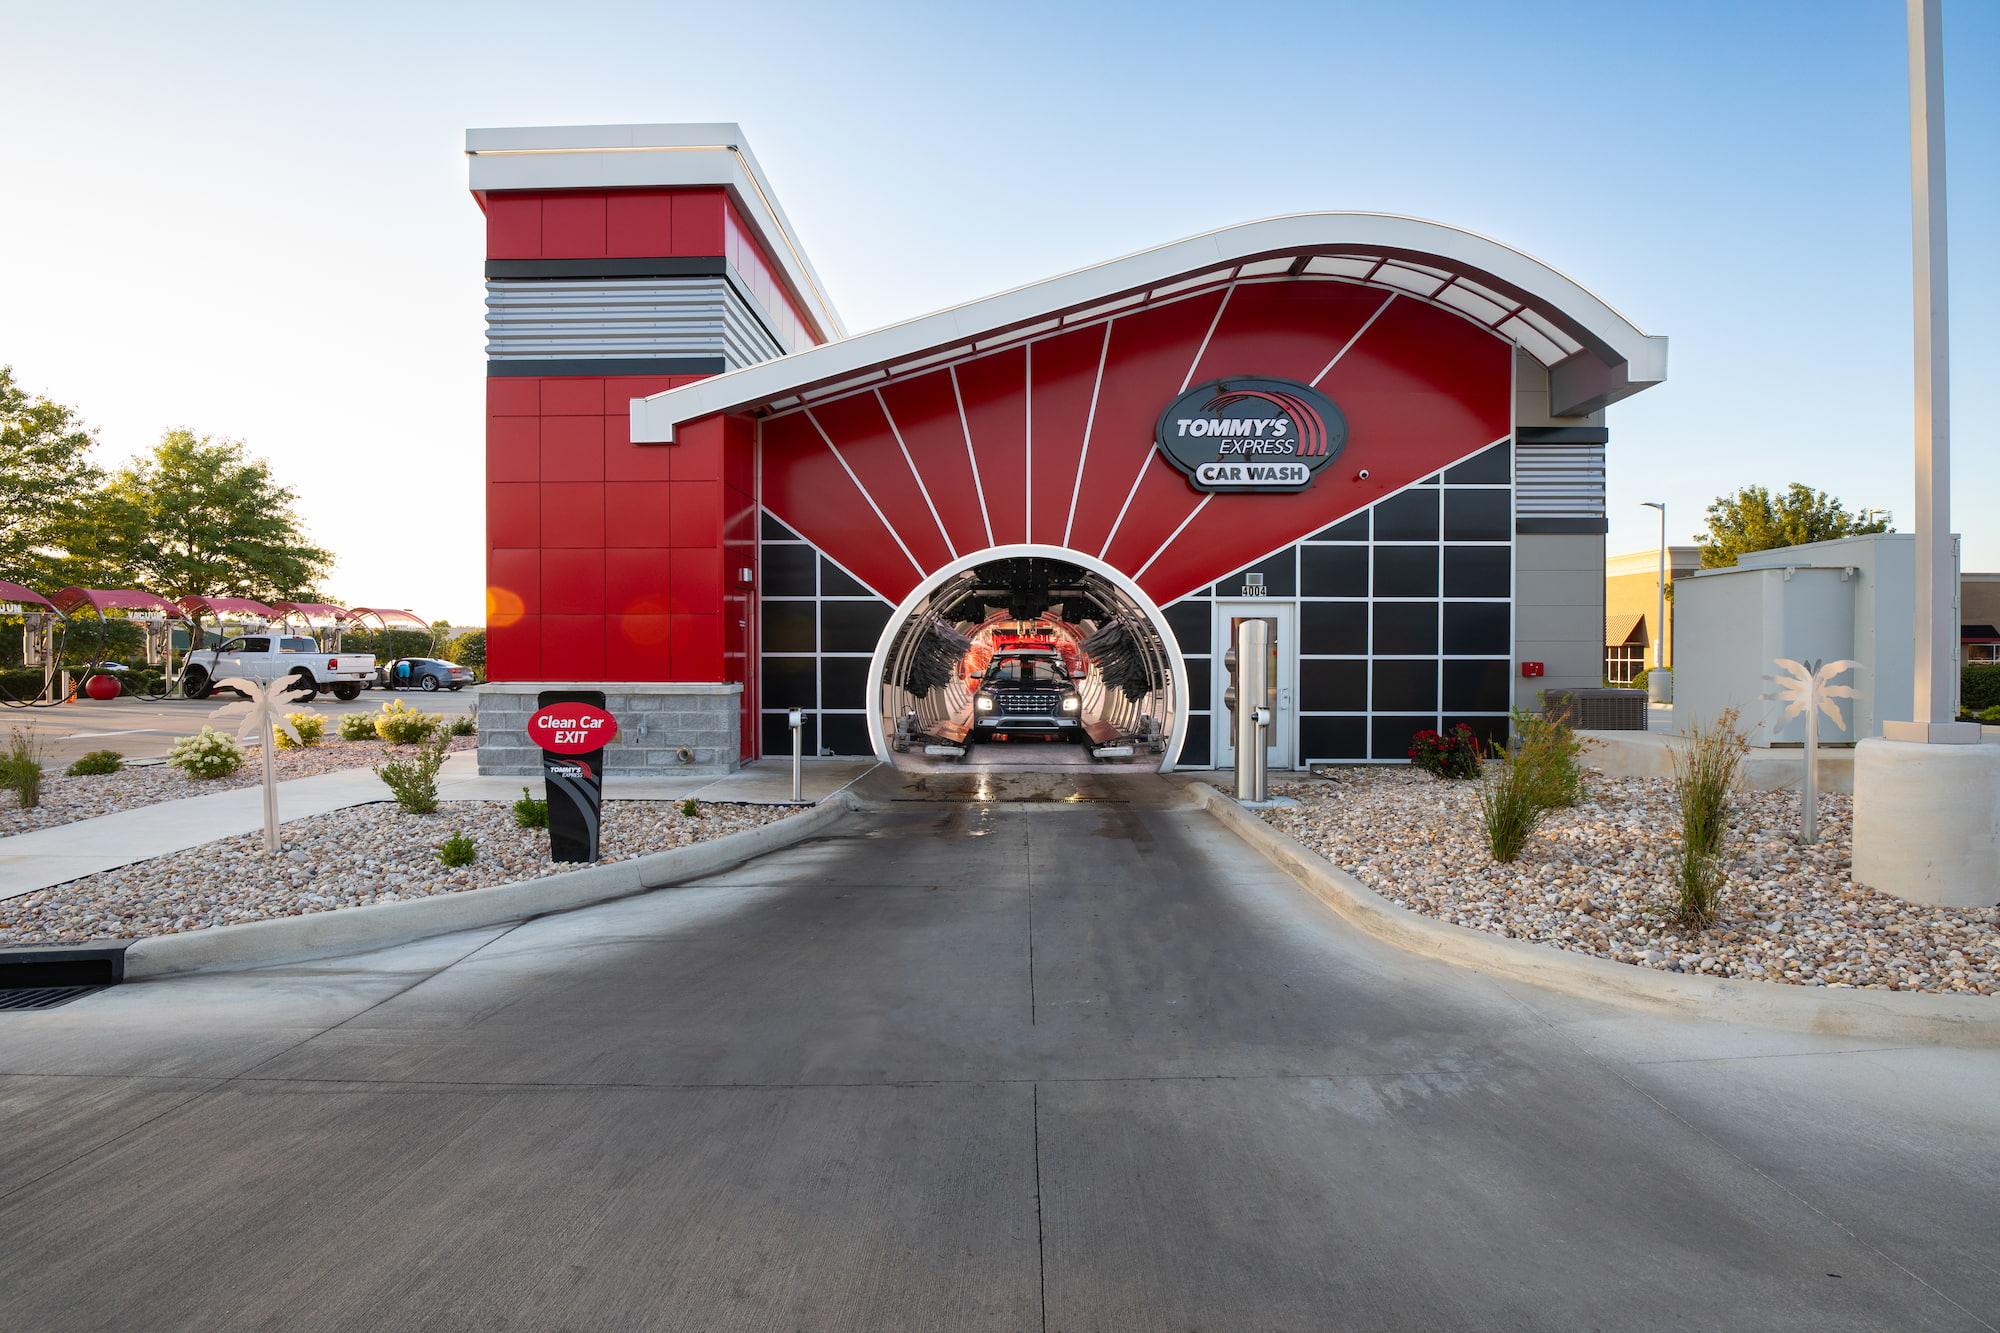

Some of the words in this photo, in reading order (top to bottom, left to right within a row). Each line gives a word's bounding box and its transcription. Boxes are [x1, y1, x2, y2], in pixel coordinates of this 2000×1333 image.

[1177, 419, 1289, 436] TOMMY'S
[1219, 439, 1294, 454] EXPRESS
[1203, 466, 1242, 481] CAR
[1247, 466, 1303, 481] WASH
[1242, 586, 1266, 596] 4004
[127, 611, 163, 620] VACUUM
[538, 715, 576, 728] Clean
[580, 715, 604, 728] Car
[555, 731, 588, 743] EXIT
